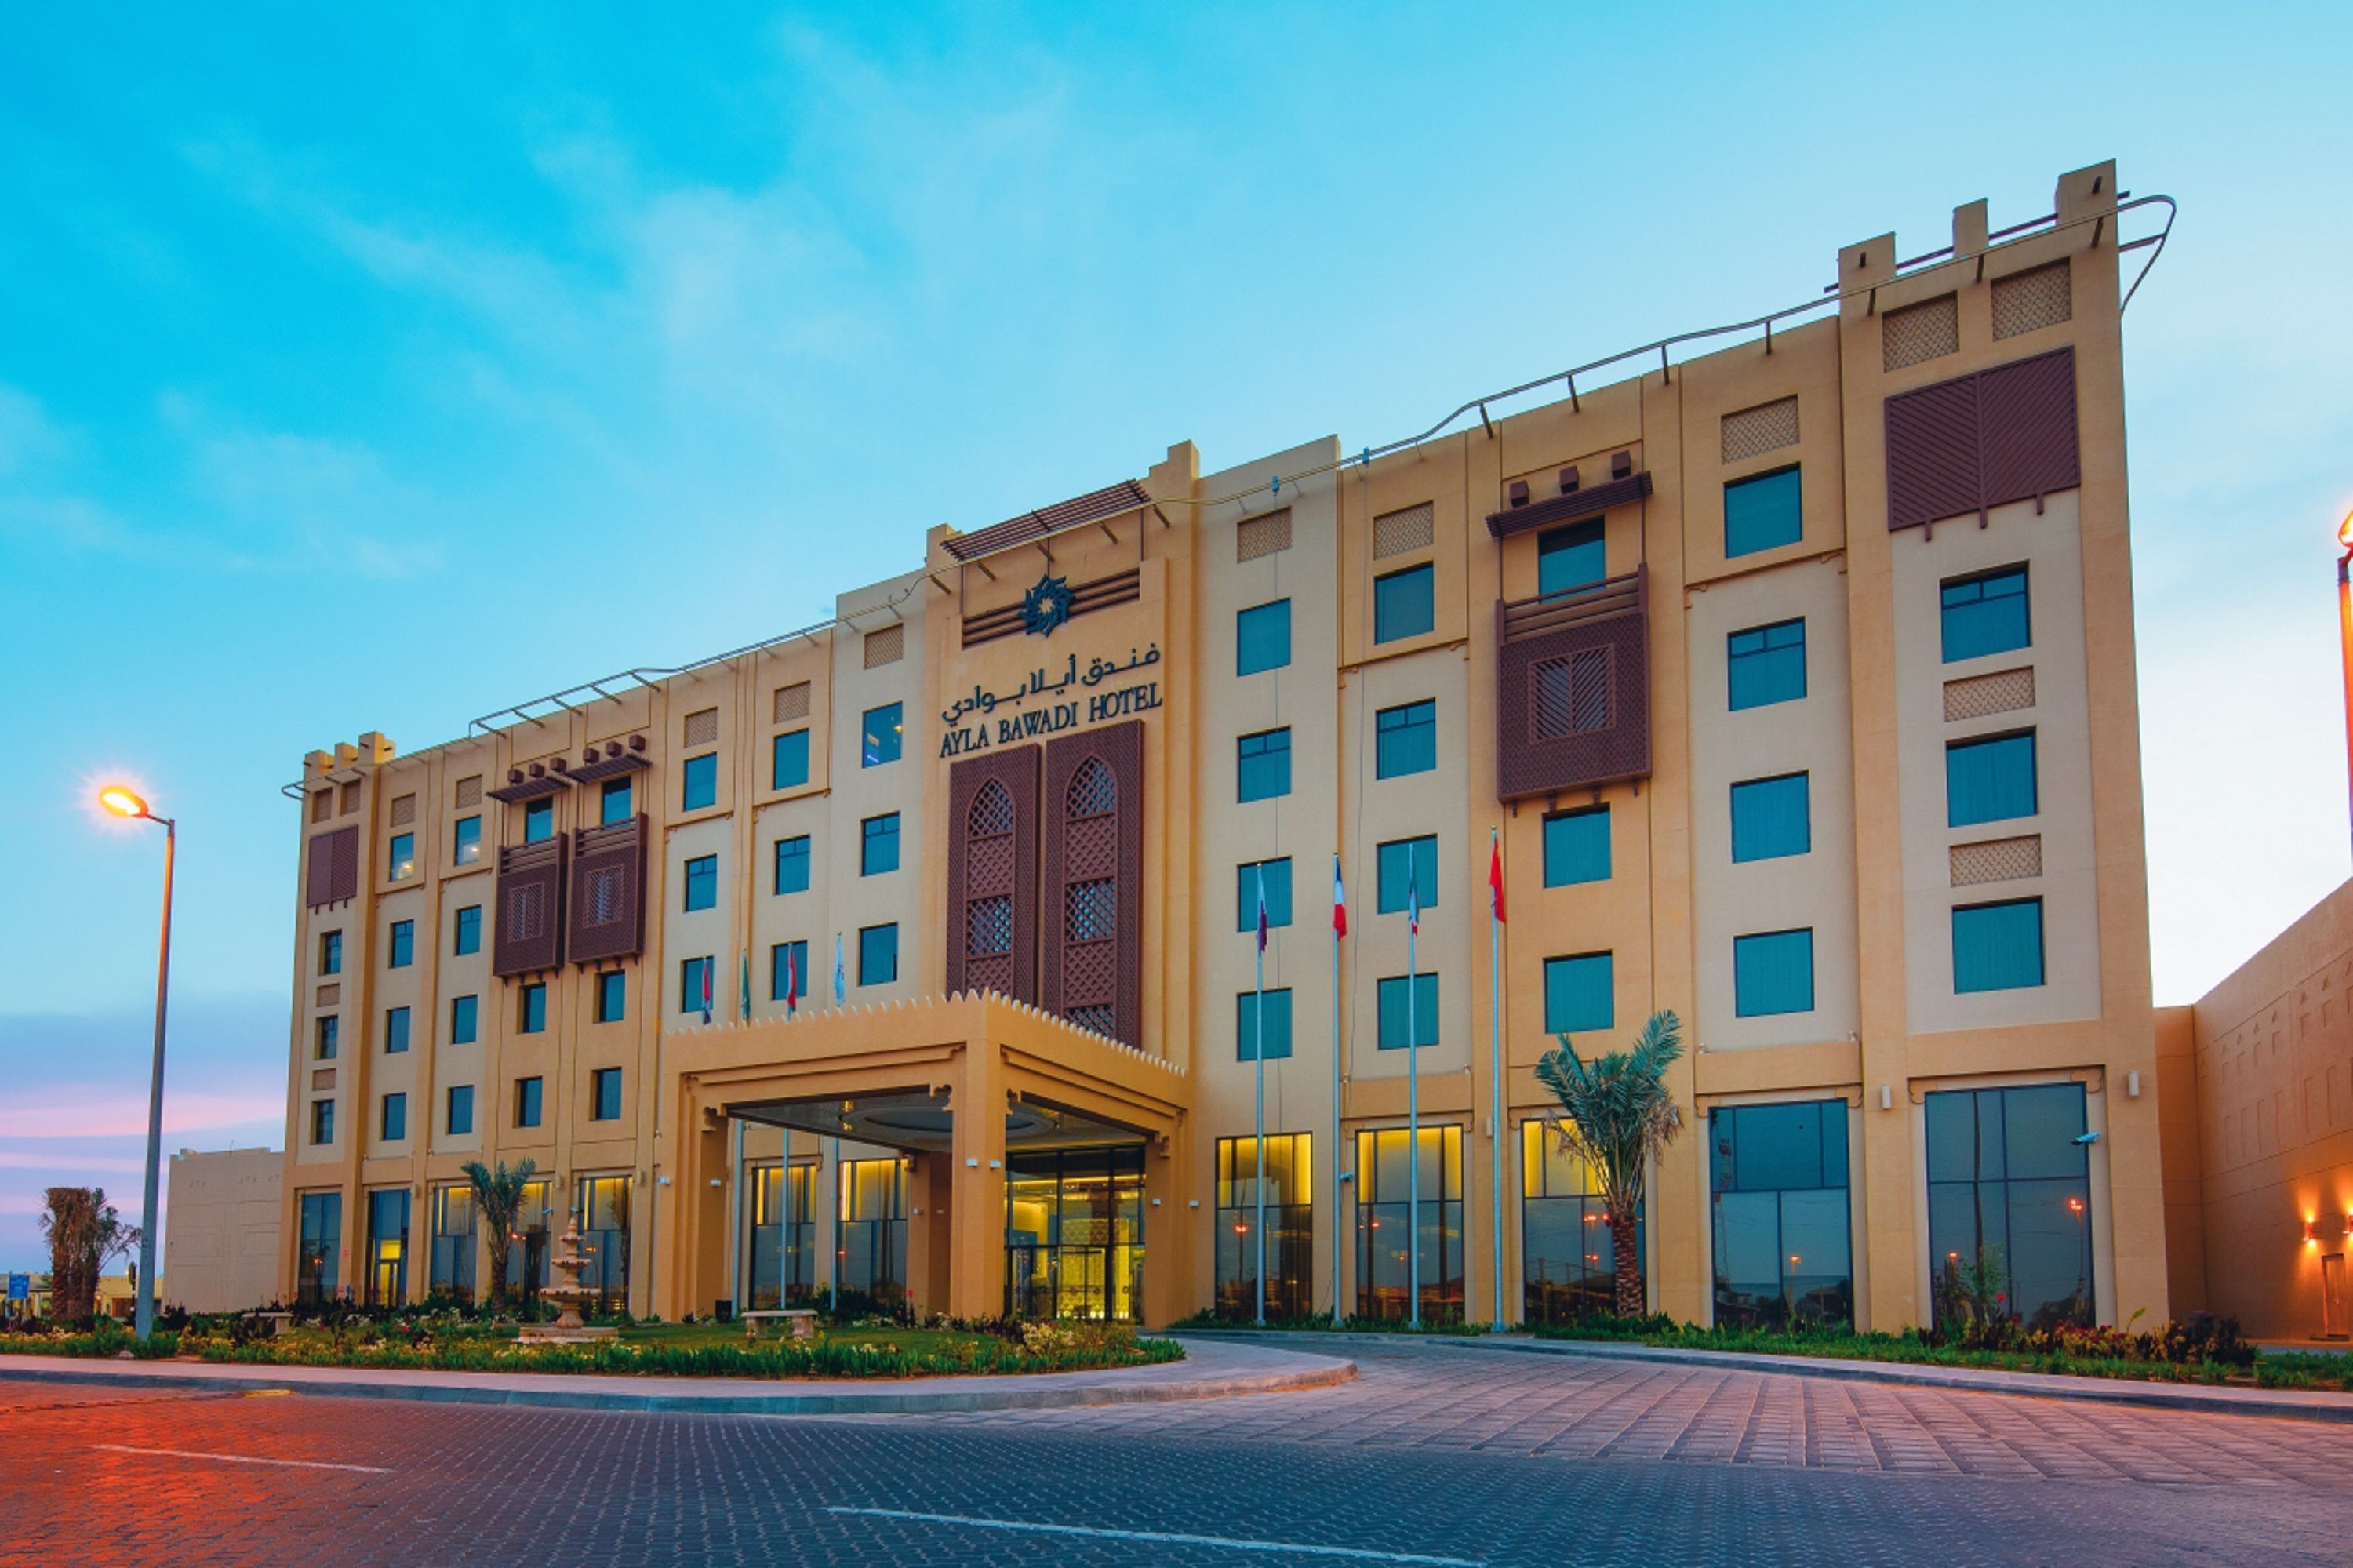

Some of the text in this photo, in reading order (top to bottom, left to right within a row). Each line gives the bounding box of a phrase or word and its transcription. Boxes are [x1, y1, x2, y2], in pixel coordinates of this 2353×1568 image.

[1081, 642, 1161, 686] فندق
[939, 681, 1163, 759] AYLA BAWADI HOTEL
[941, 684, 1026, 729] بوادي
